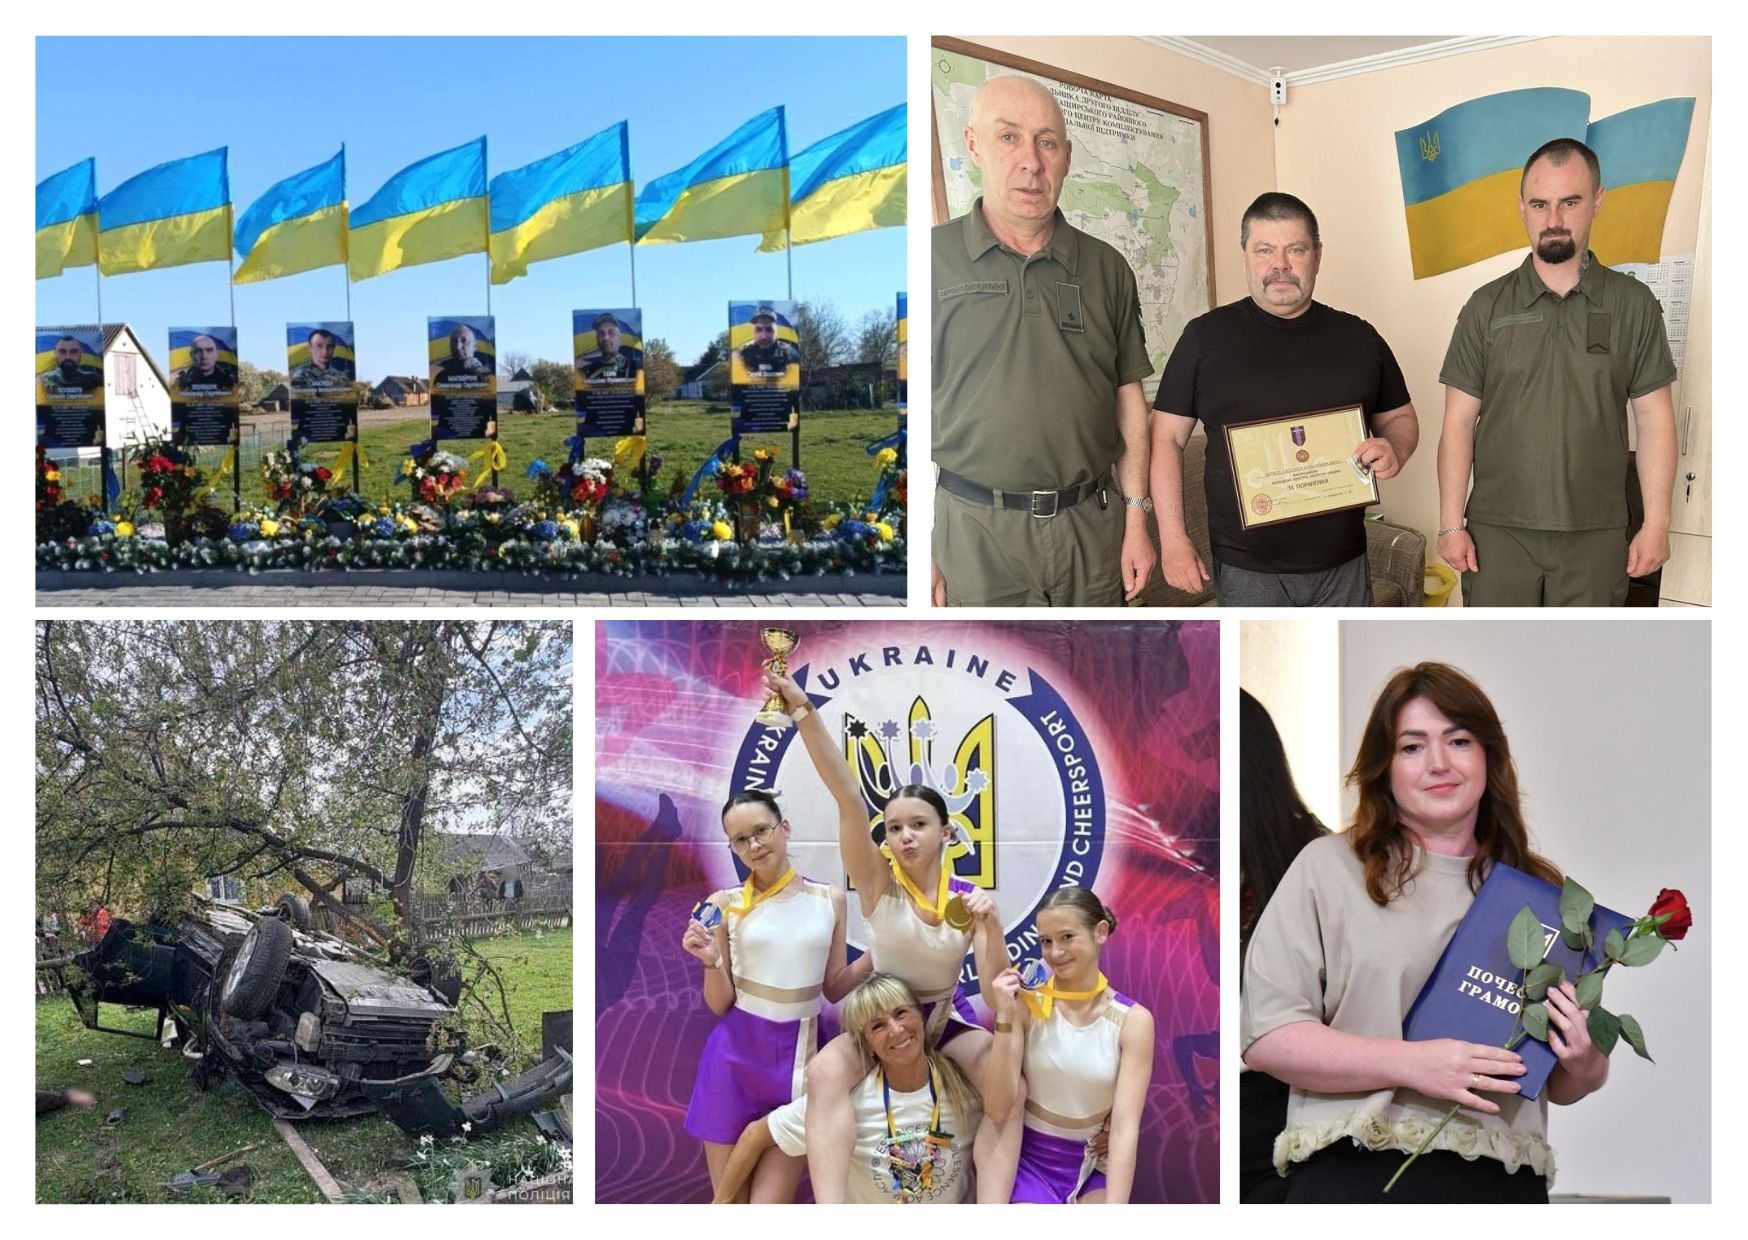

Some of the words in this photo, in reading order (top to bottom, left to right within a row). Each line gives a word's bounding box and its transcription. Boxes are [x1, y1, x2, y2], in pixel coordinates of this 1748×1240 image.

[1049, 87, 1080, 102] ЛЬНИКА
[1081, 97, 1112, 110] ДРУГОГО
[1059, 82, 1089, 96] РОБОЧА
[1090, 90, 1113, 103] КАРТА
[1059, 99, 1108, 118] АШИРСЬКОГО
[1074, 111, 1102, 124] ЦЕНТРУ
[817, 645, 1017, 693] UKRAINE
[744, 725, 788, 792] KRAIN
[1040, 710, 1092, 856] CHEERSPORT
[1457, 980, 1521, 1015] ГРАМО
[1466, 964, 1526, 999] ПОЧЕС
